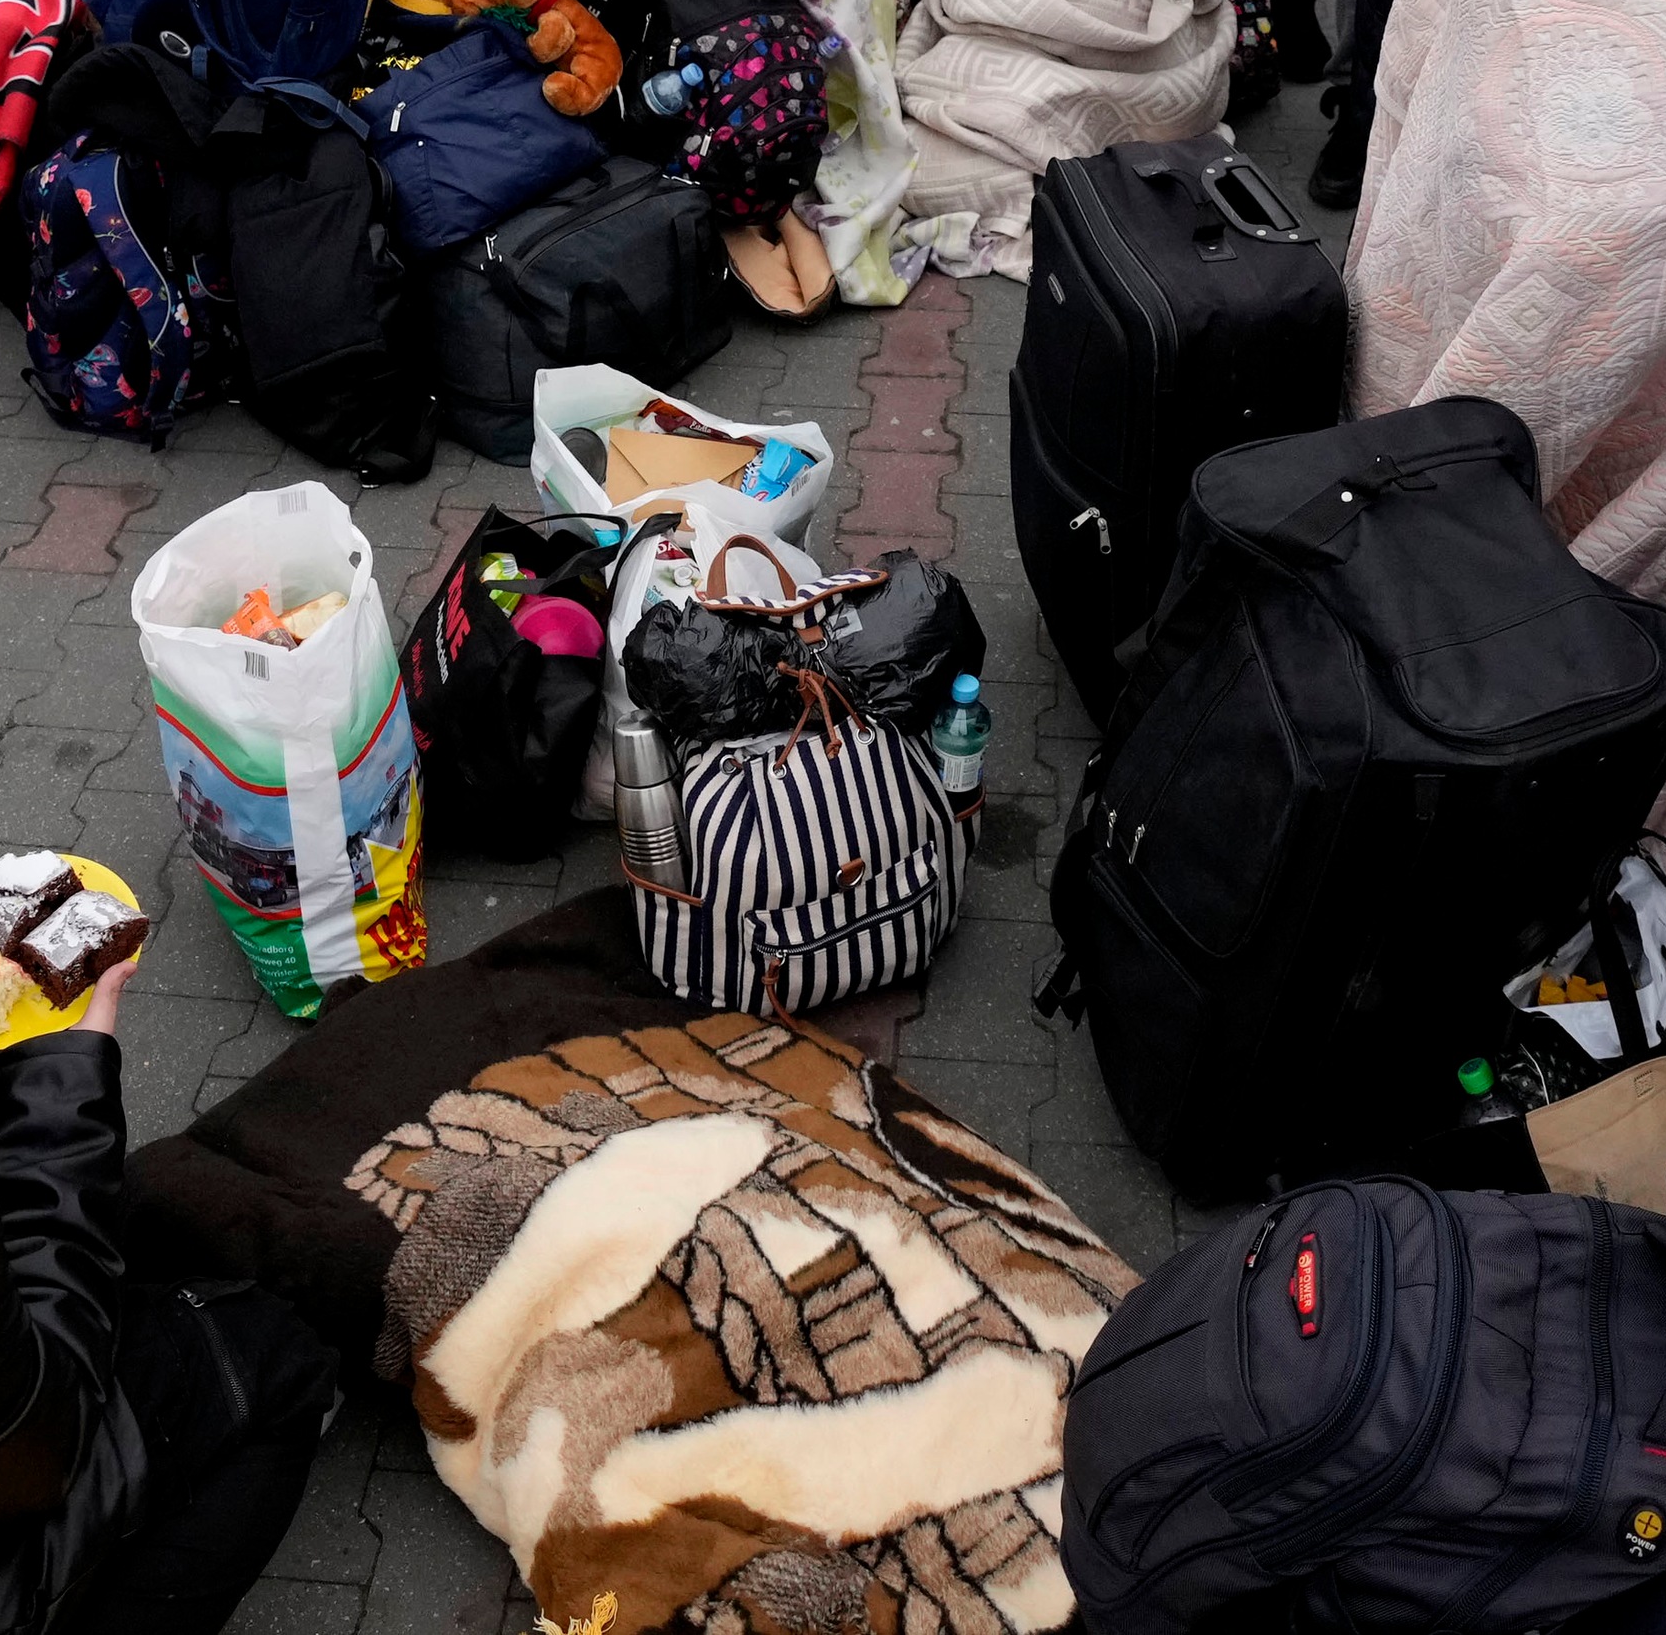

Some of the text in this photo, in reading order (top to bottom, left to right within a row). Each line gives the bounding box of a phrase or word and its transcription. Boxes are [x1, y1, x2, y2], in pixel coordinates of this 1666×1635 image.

[284, 956, 296, 965] 40
[1303, 1267, 1313, 1308] POWER
[1625, 1532, 1657, 1552] POWER
